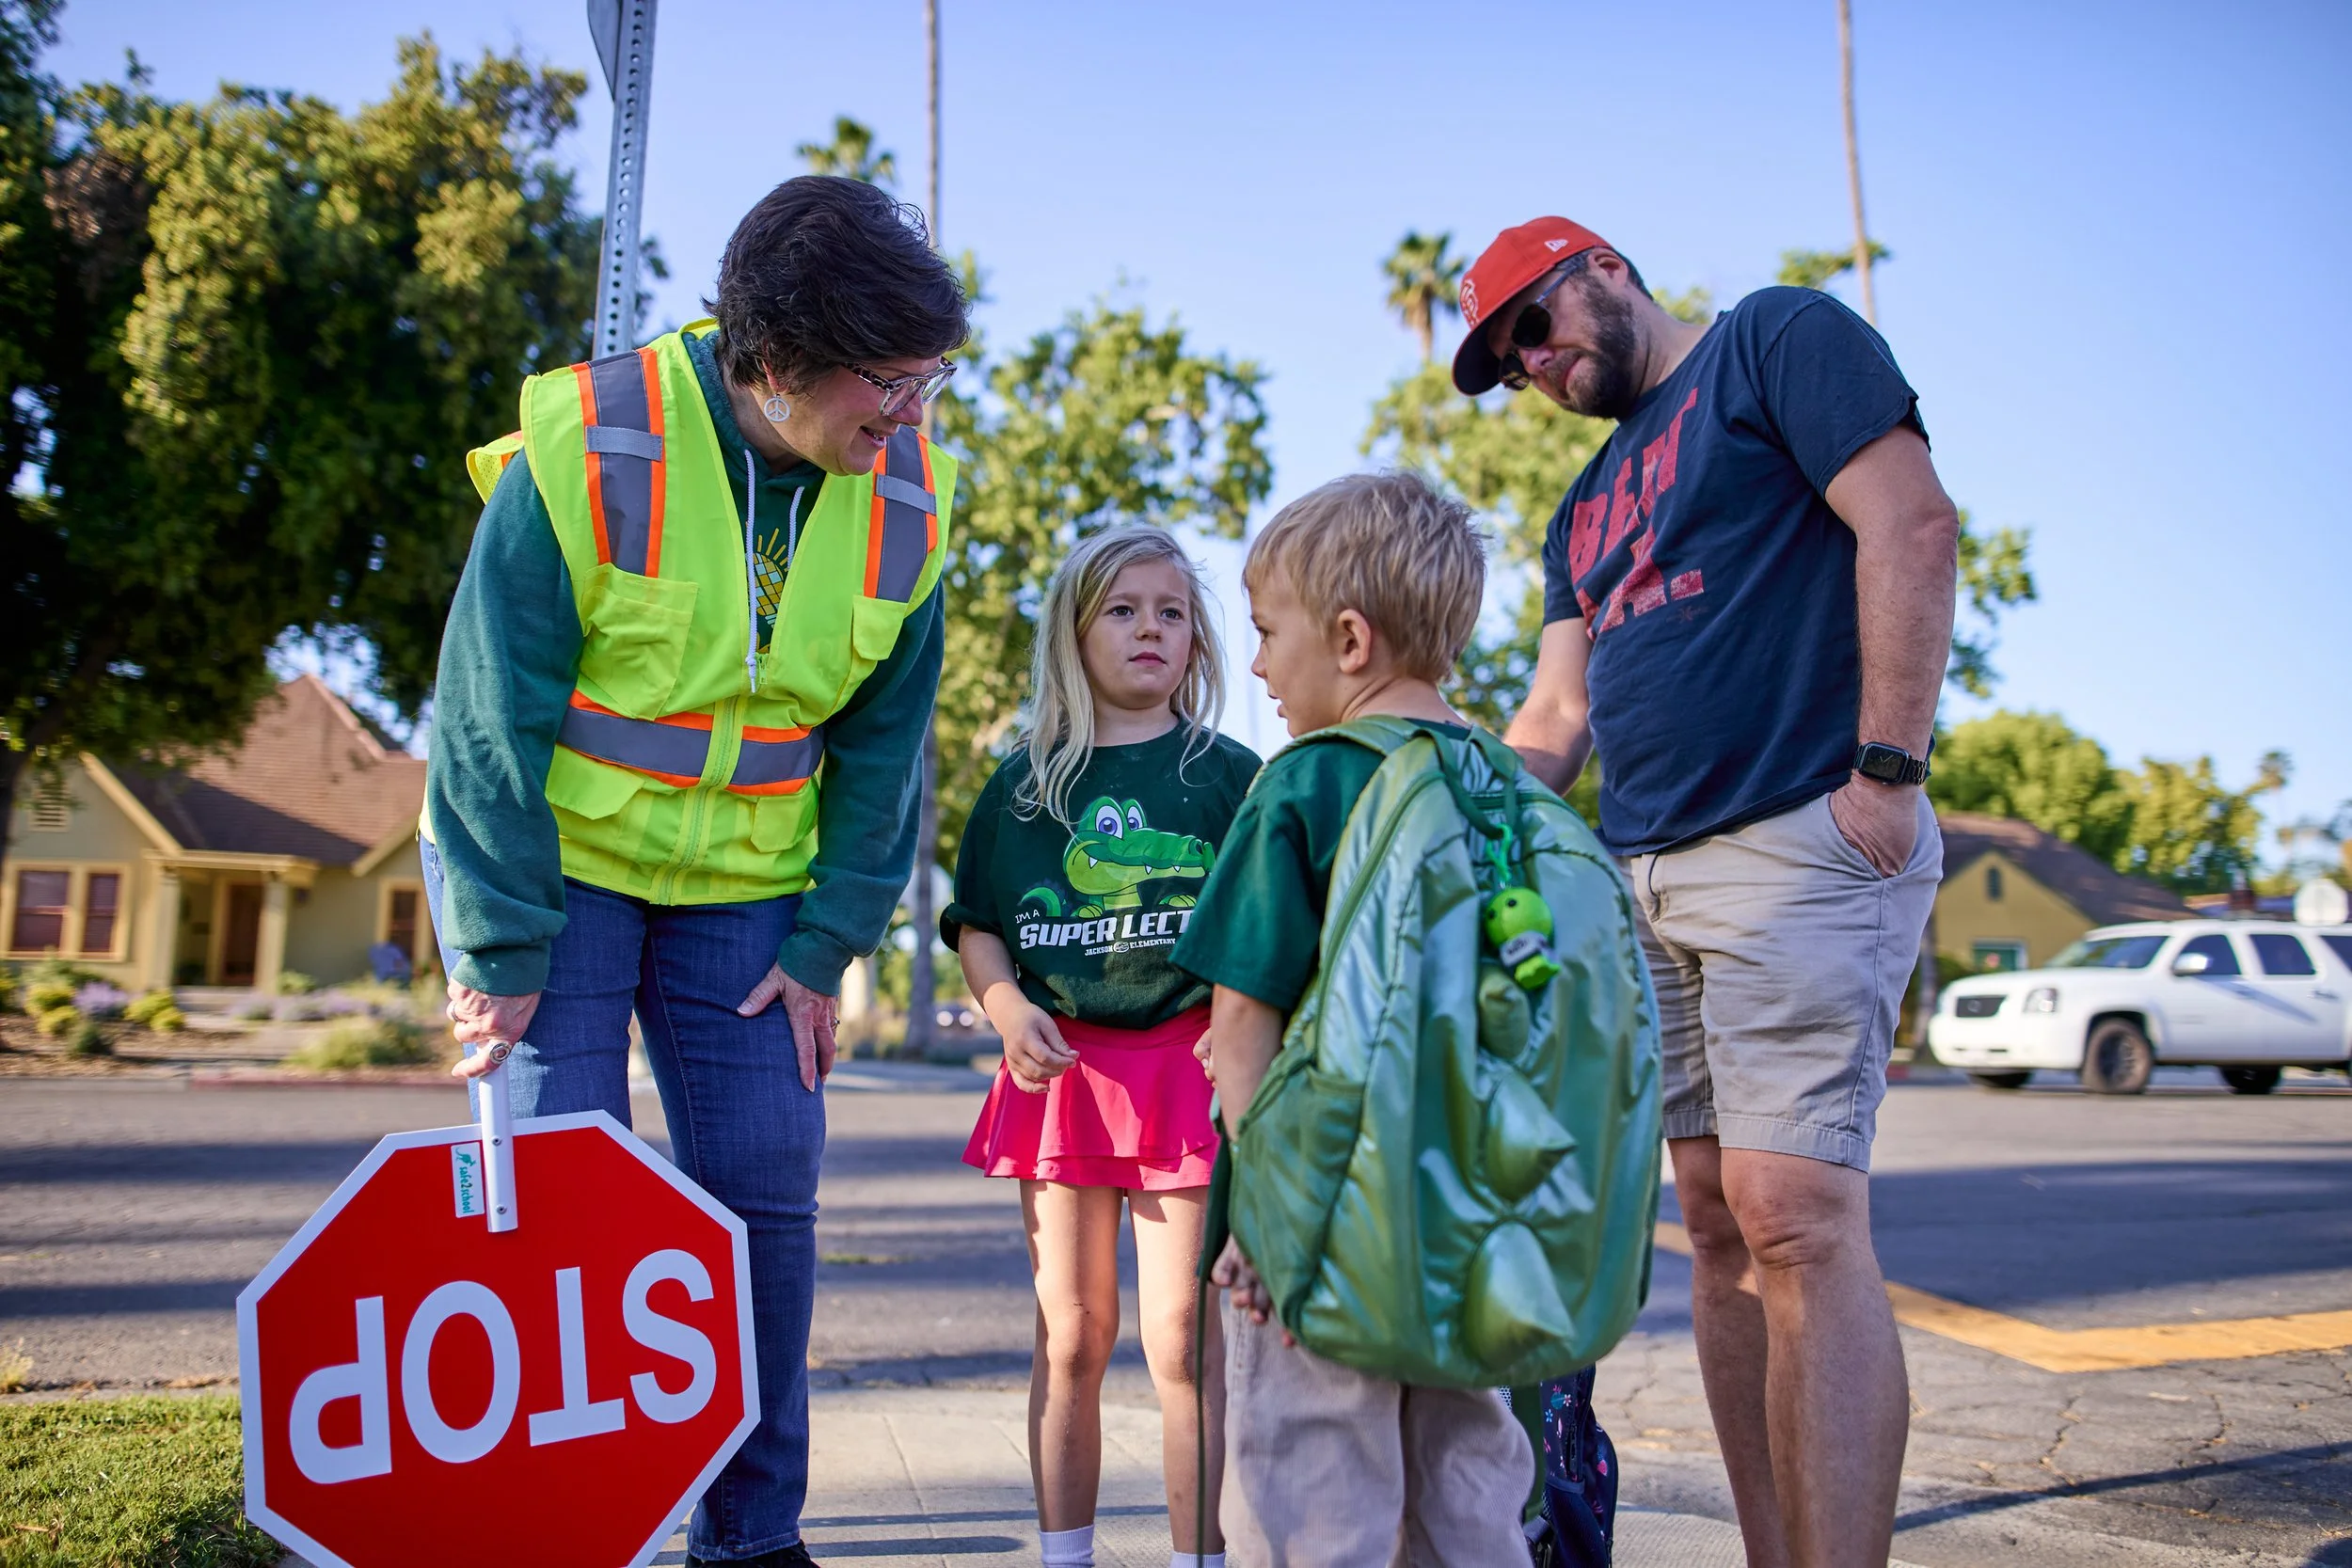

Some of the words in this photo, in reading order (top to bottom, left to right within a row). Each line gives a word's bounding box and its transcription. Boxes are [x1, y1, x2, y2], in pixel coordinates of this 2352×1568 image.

[1033, 909, 1041, 918] A
[1019, 916, 1118, 950] SUPER
[1084, 944, 1114, 957] JACKSON
[1129, 938, 1176, 949] ELEMENTARY
[459, 1166, 475, 1214] safe2school
[288, 1248, 718, 1485] STOP
